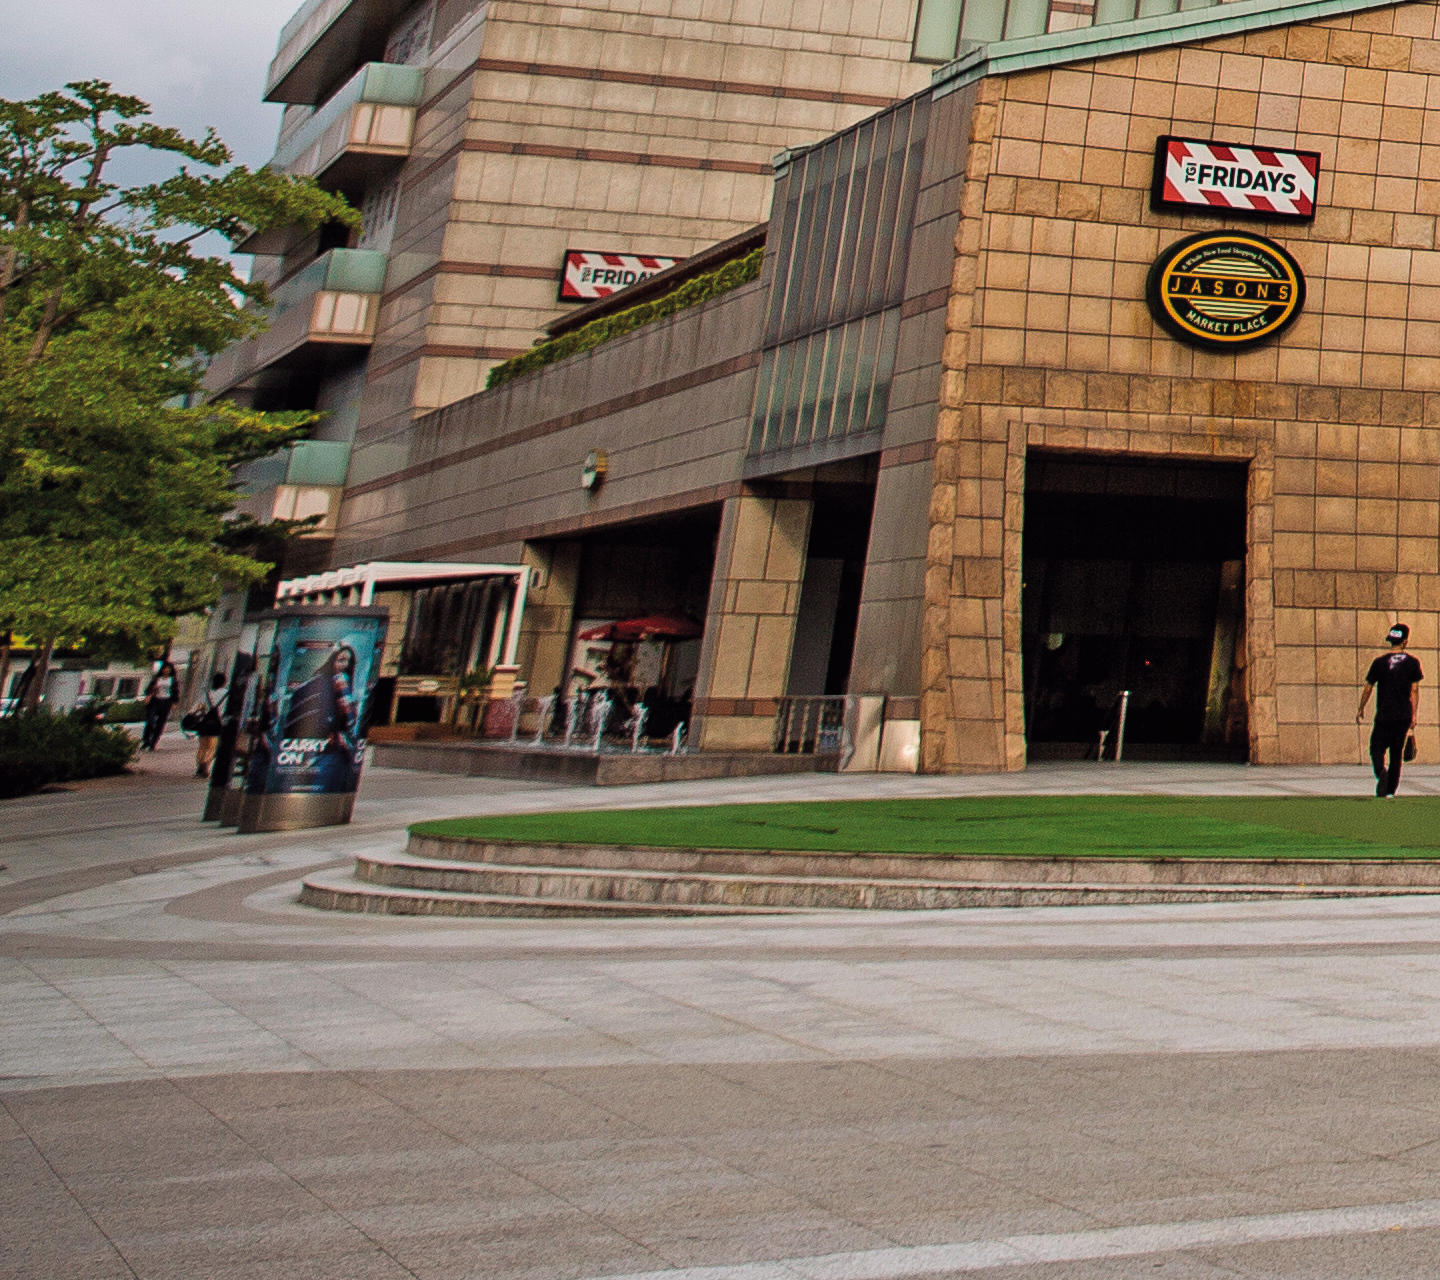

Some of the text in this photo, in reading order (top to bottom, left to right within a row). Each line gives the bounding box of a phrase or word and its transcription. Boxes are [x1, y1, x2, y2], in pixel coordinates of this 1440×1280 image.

[1184, 162, 1297, 194] TGI FRIDAYS
[1185, 309, 1268, 333] MARKET PLACE
